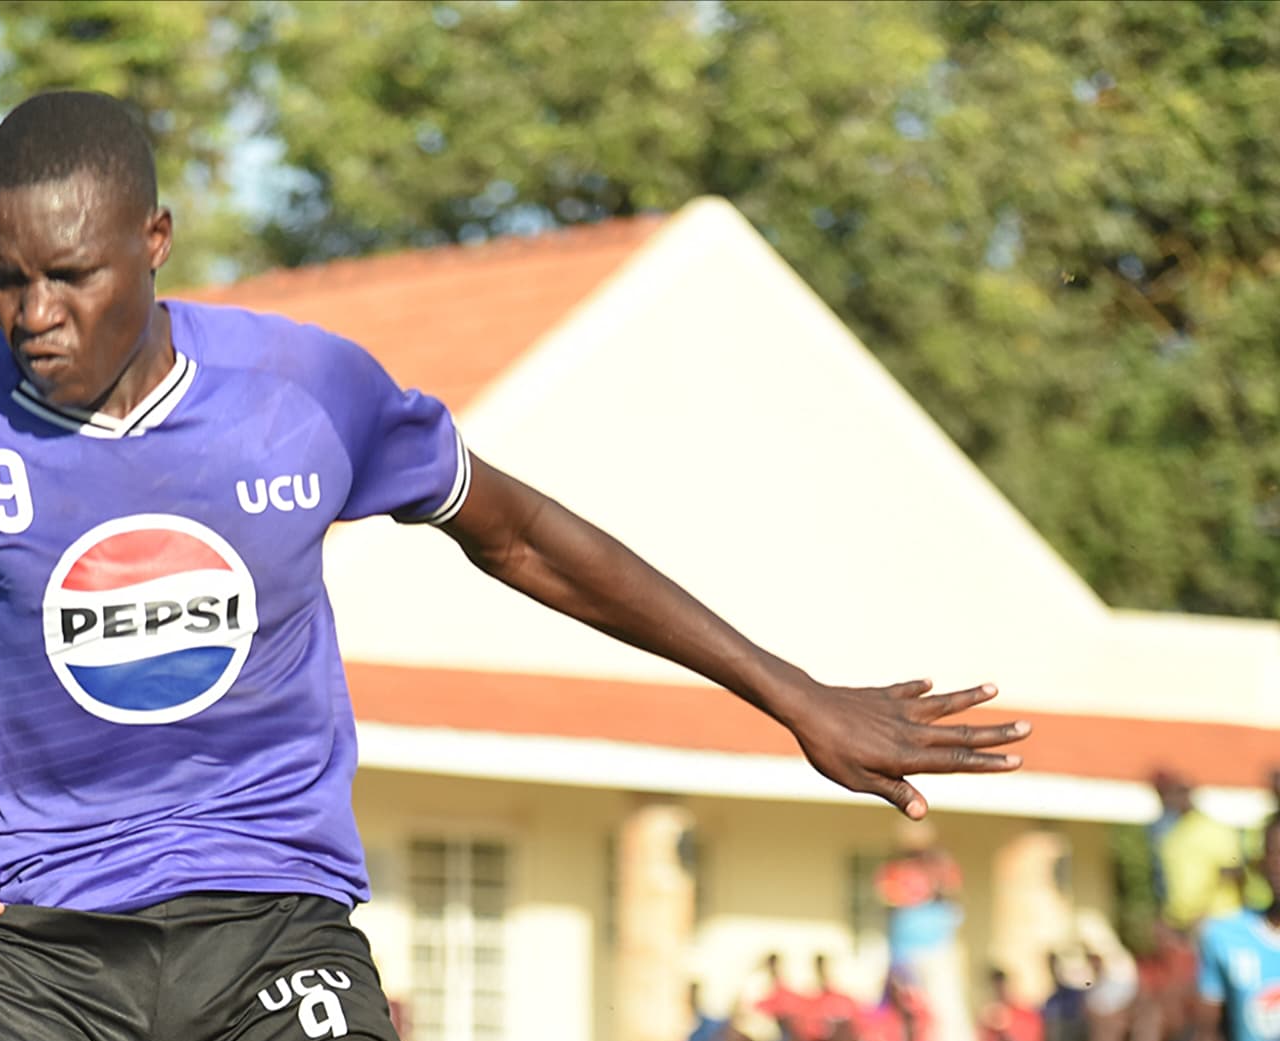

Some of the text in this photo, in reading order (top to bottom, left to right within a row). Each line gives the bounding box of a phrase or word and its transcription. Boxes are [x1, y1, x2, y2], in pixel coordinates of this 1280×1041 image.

[235, 472, 320, 514] UCU
[60, 594, 240, 644] PEPSI
[257, 969, 352, 1011] UCU
